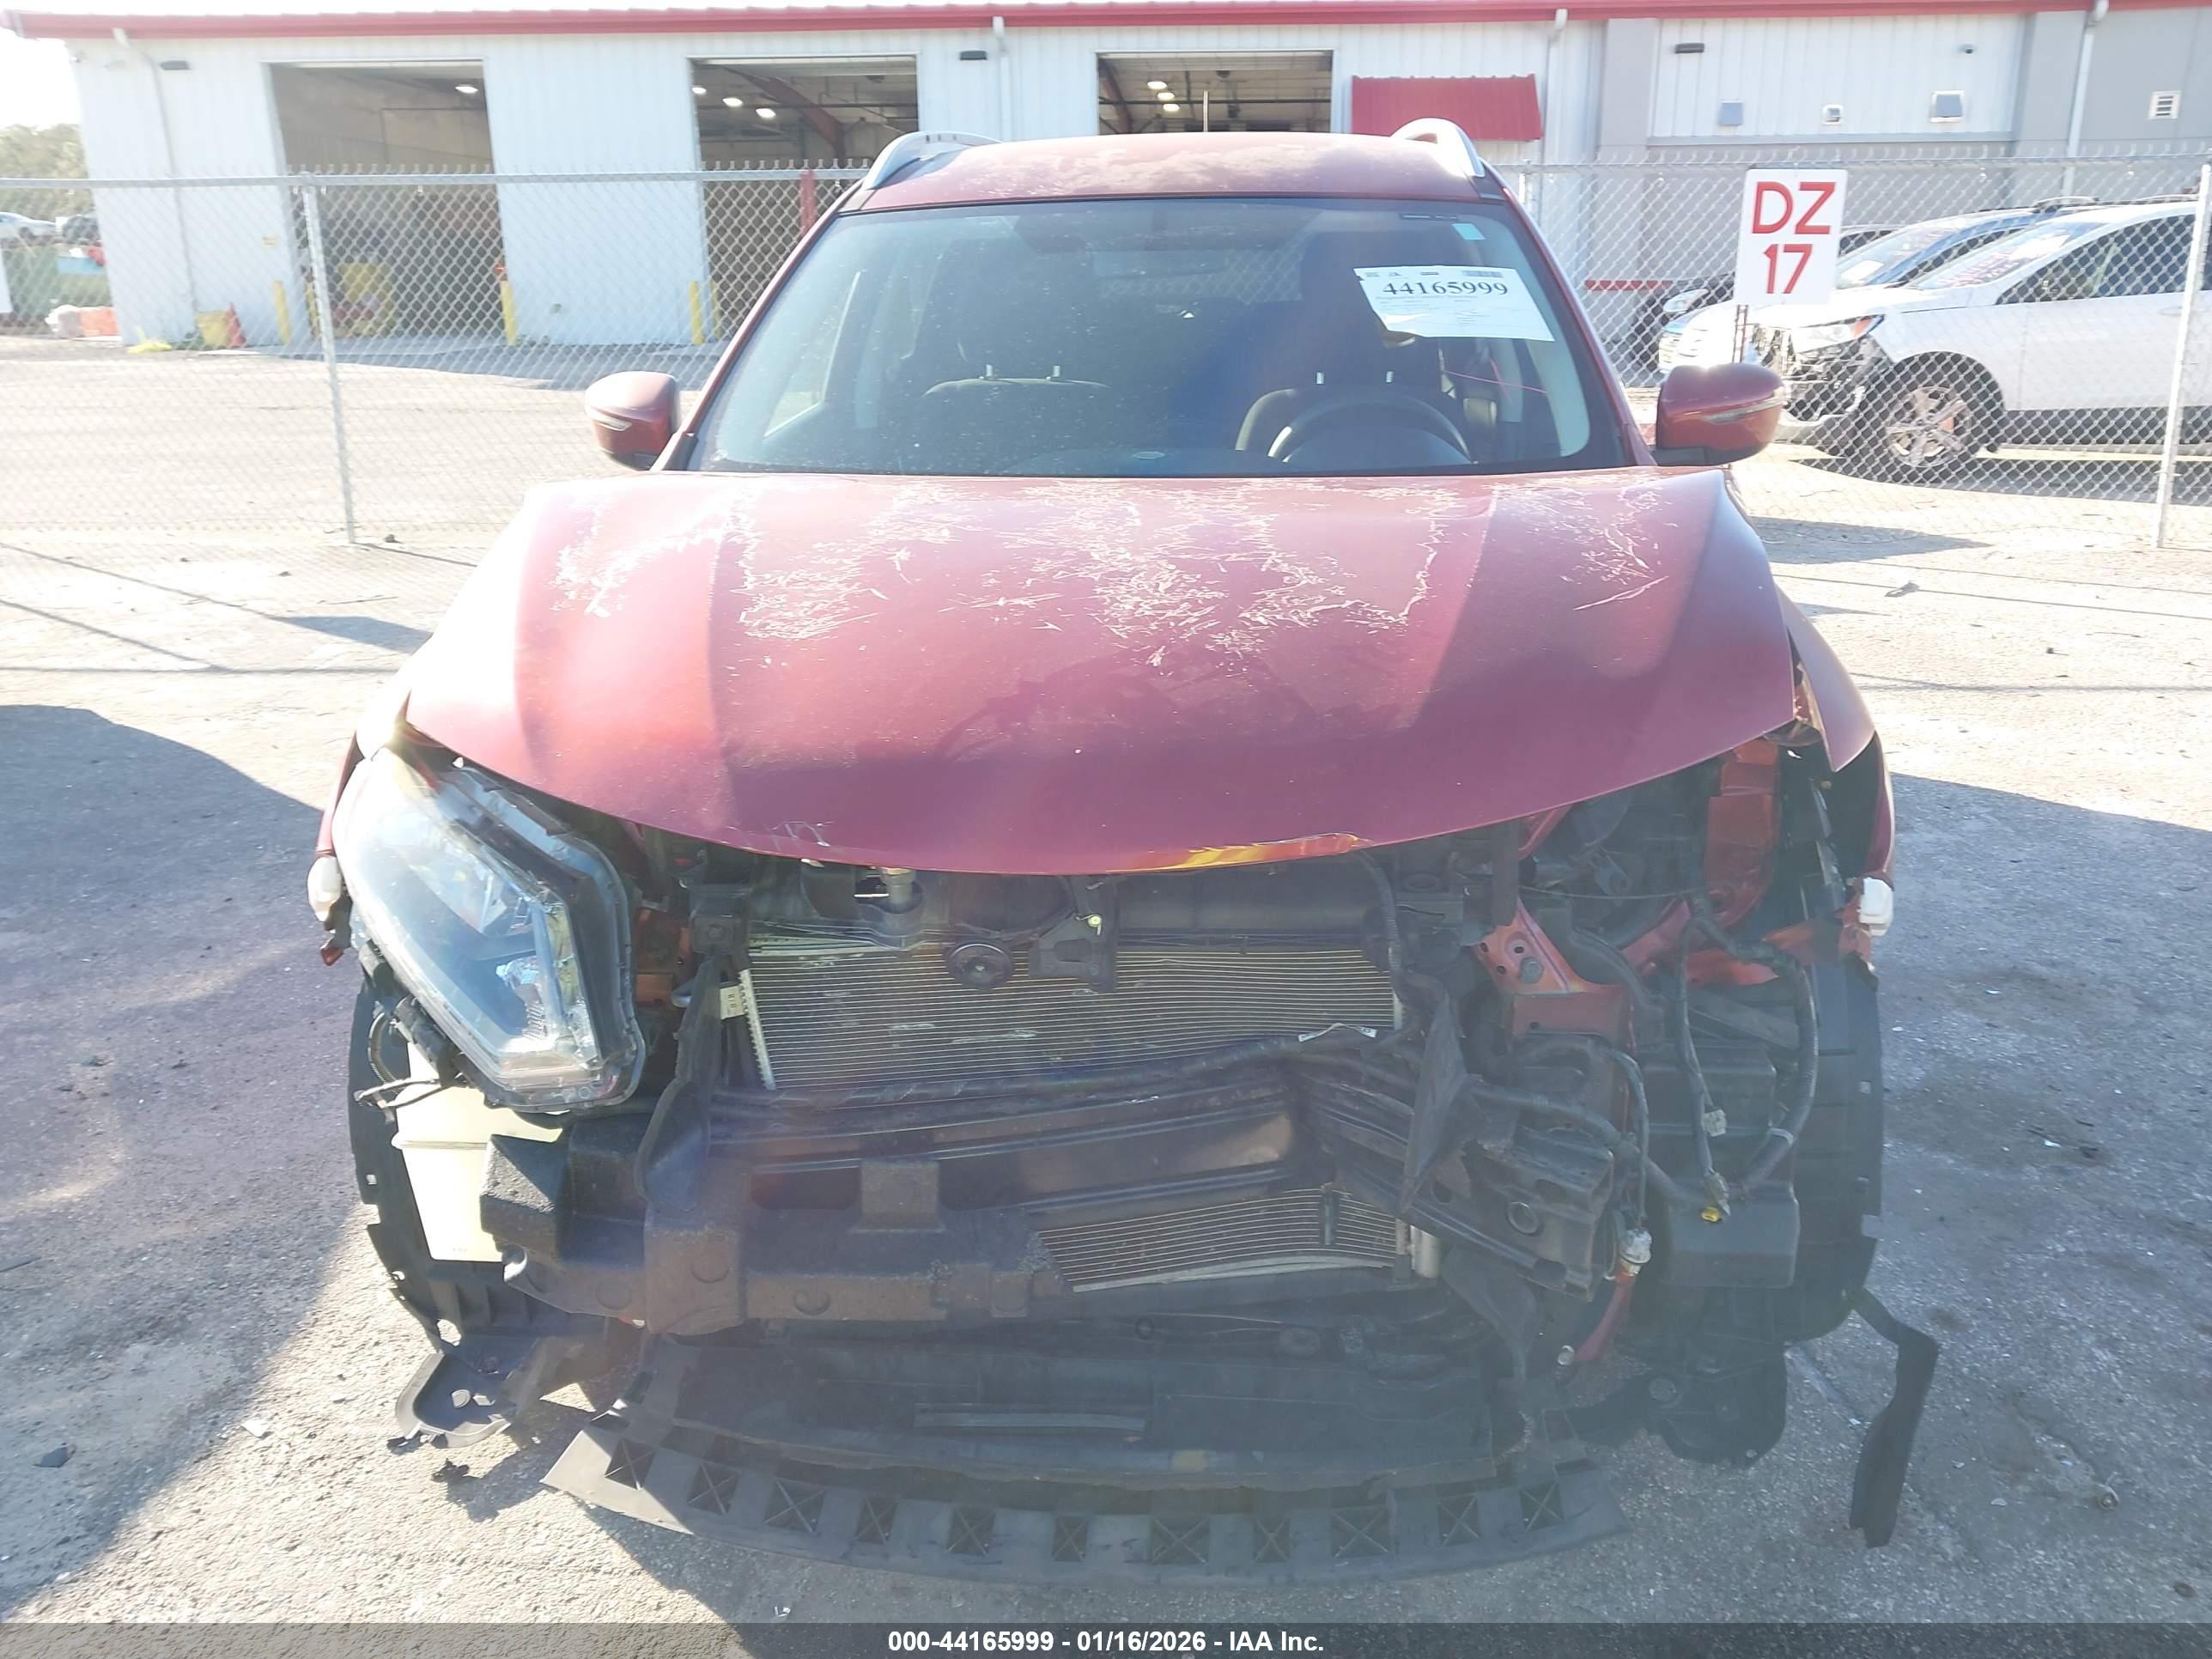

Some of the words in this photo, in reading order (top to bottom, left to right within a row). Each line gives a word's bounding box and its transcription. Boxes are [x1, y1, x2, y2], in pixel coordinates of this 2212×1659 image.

[1752, 181, 1836, 234] DZ
[1382, 281, 1509, 295] 44165999
[1763, 244, 1814, 294] 17
